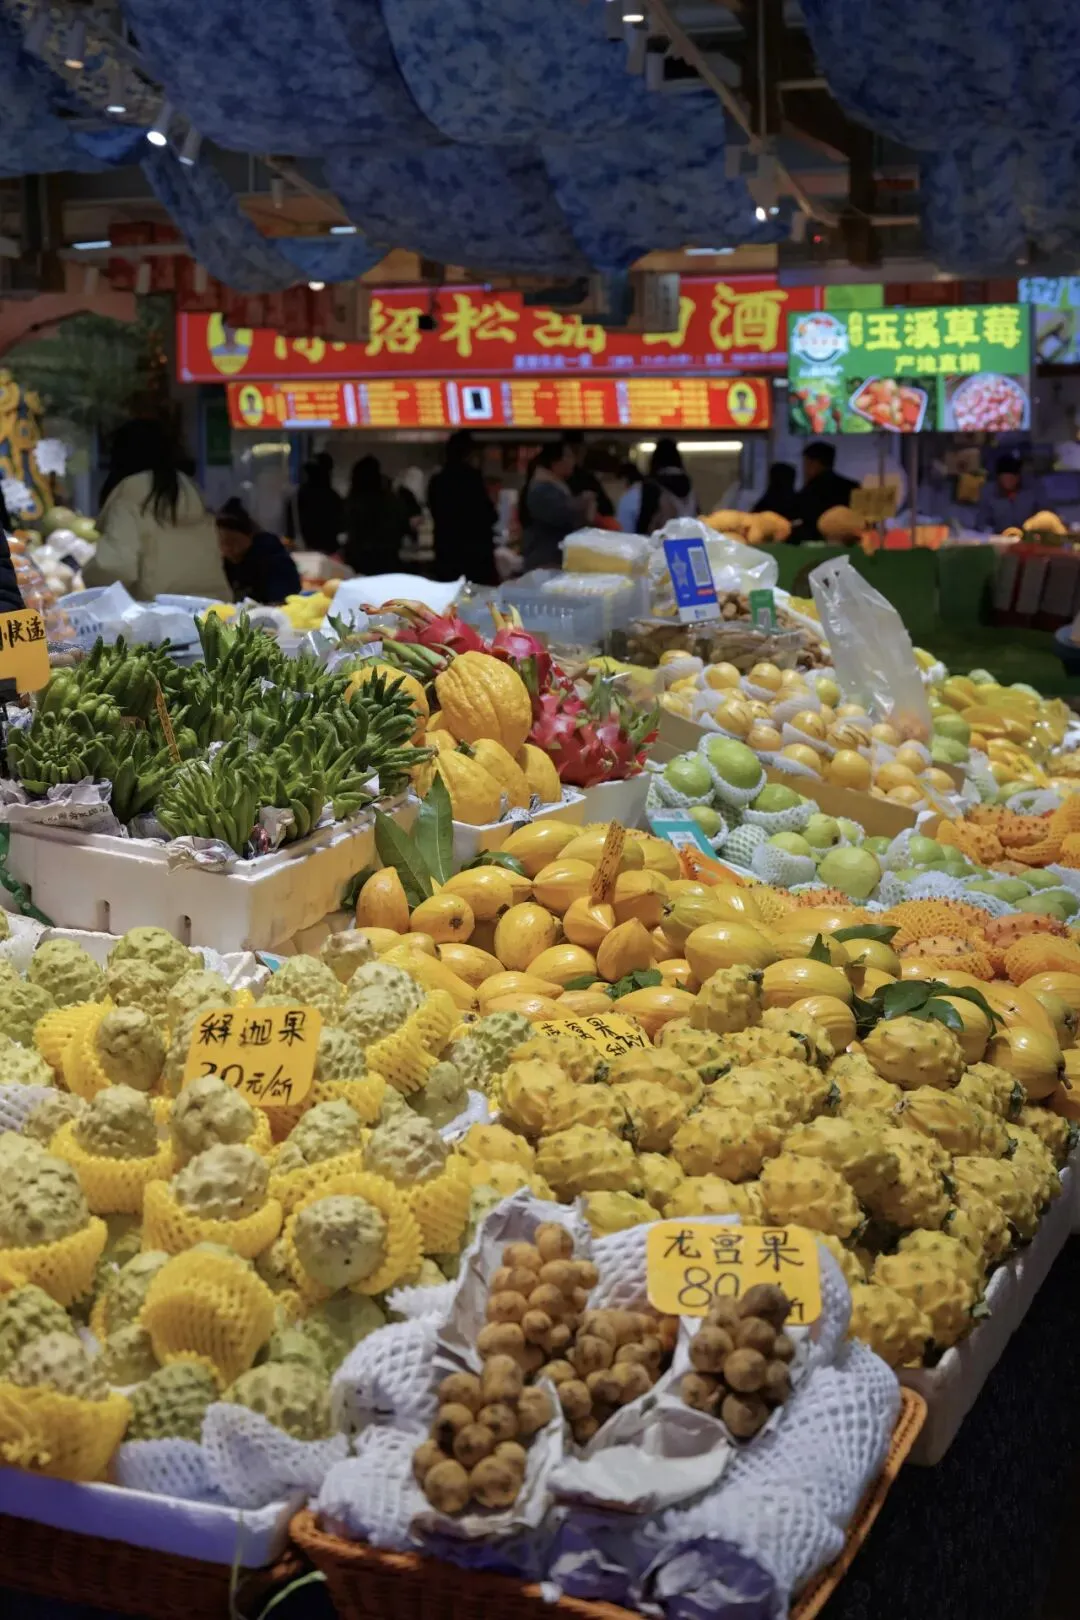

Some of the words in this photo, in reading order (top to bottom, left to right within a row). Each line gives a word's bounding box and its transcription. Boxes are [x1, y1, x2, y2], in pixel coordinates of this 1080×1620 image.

[865, 306, 1021, 350] 玉溪草莓
[199, 1010, 306, 1047] 释迦果
[663, 1229, 804, 1273] 龙宫果
